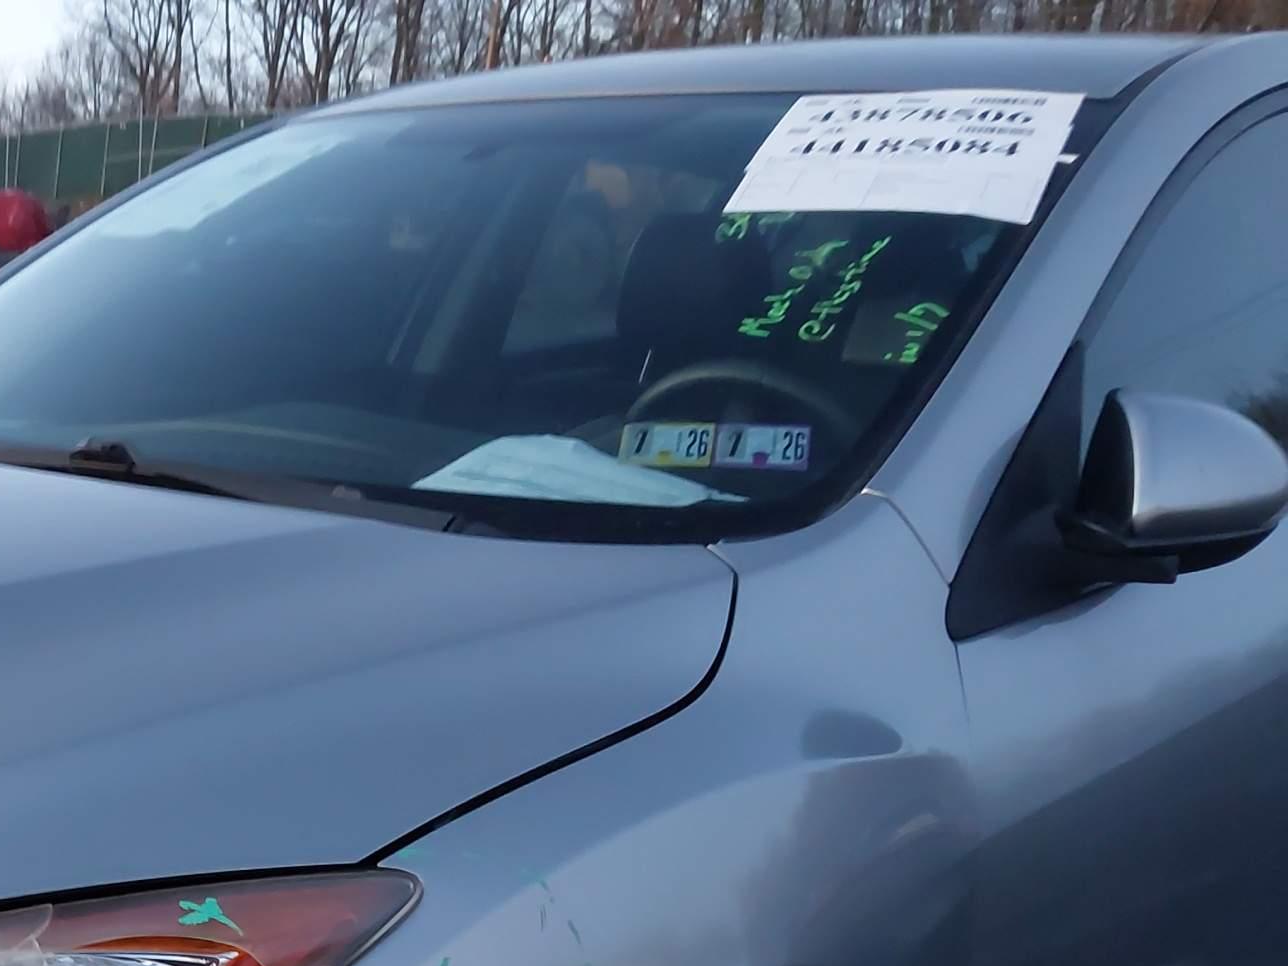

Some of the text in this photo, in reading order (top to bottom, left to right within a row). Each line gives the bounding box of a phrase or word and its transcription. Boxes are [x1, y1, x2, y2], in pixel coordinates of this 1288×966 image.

[789, 137, 1021, 156] 44185084
[634, 428, 710, 458] 7 26
[727, 430, 806, 461] 7 26
